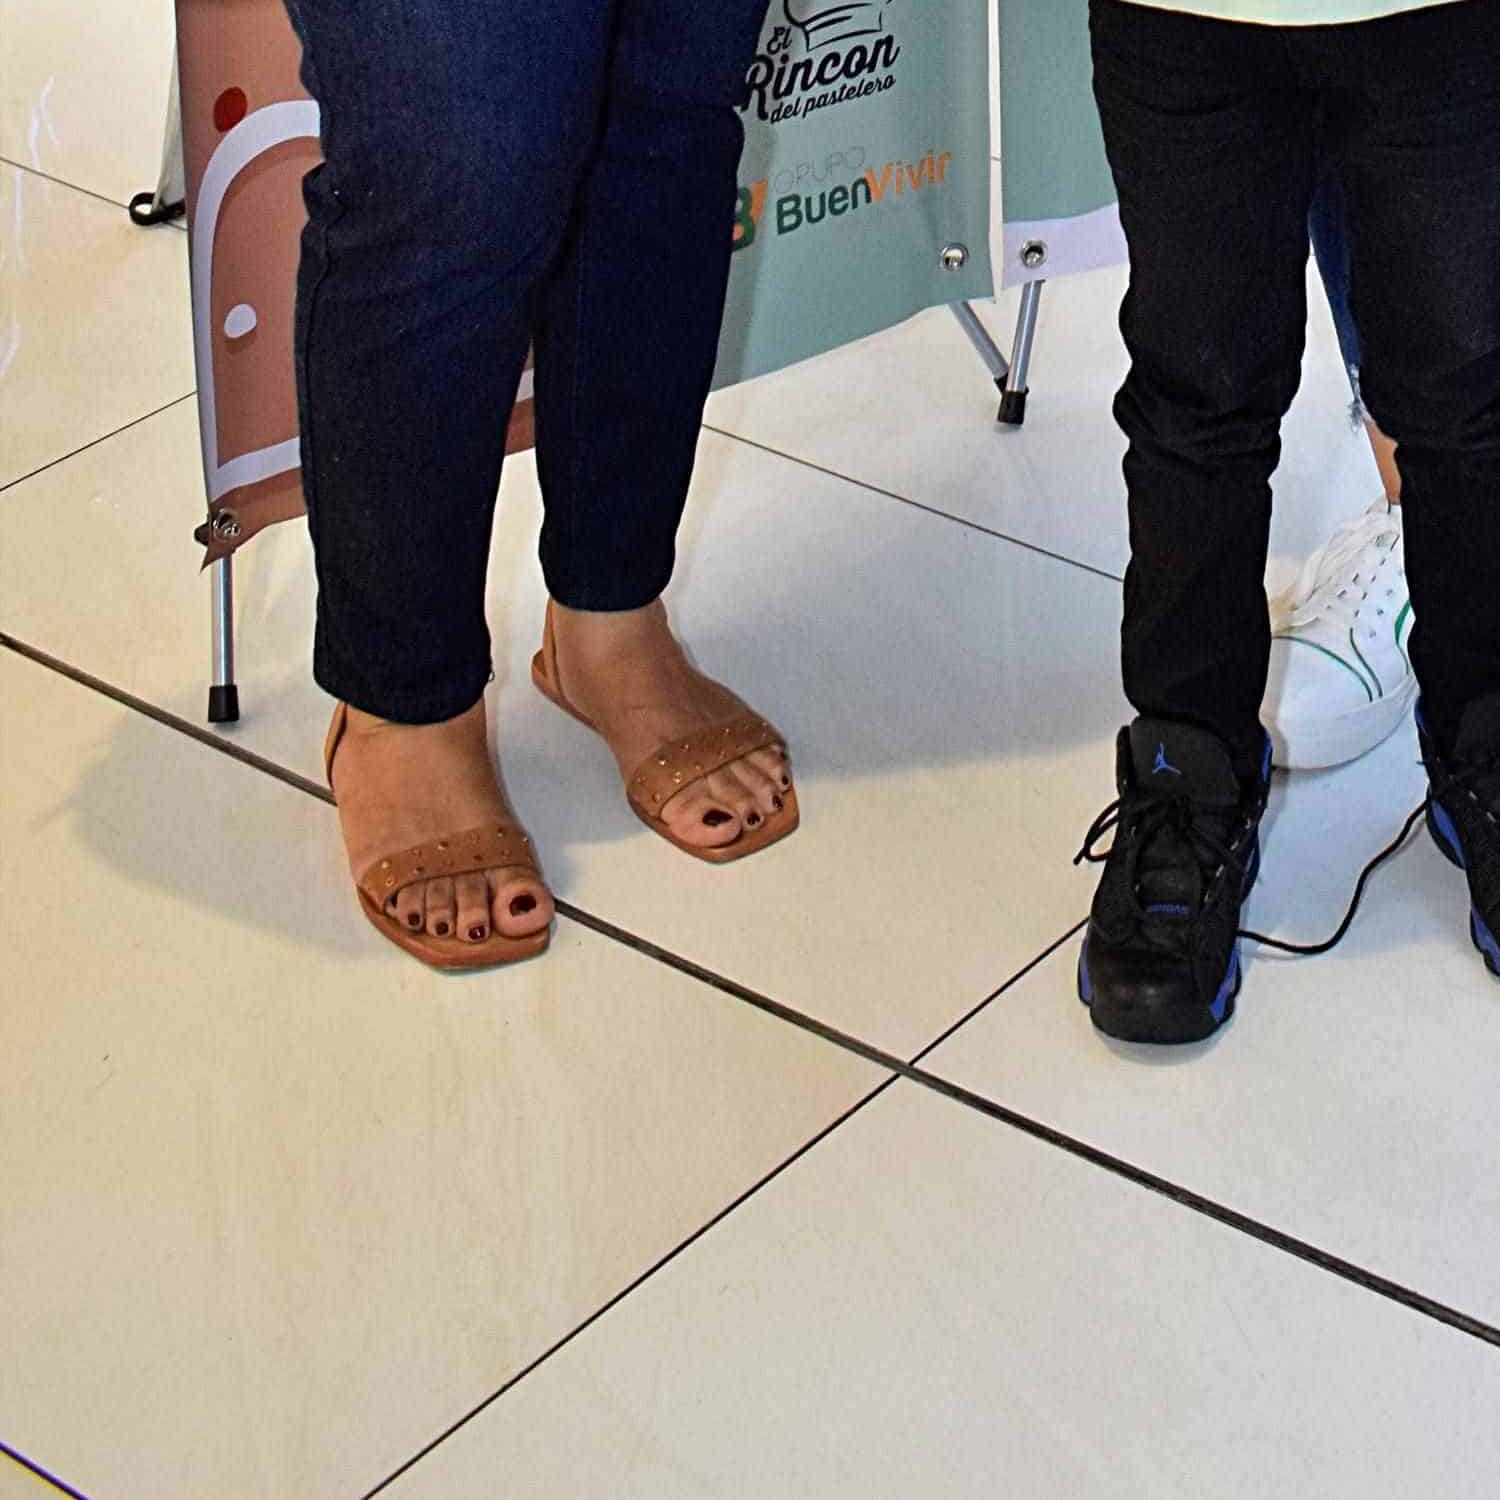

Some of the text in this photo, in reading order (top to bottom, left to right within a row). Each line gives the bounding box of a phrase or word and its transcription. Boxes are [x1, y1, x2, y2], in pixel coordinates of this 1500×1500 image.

[767, 25, 793, 55] El
[744, 34, 901, 121] Rincon
[770, 74, 897, 125] del pastelero
